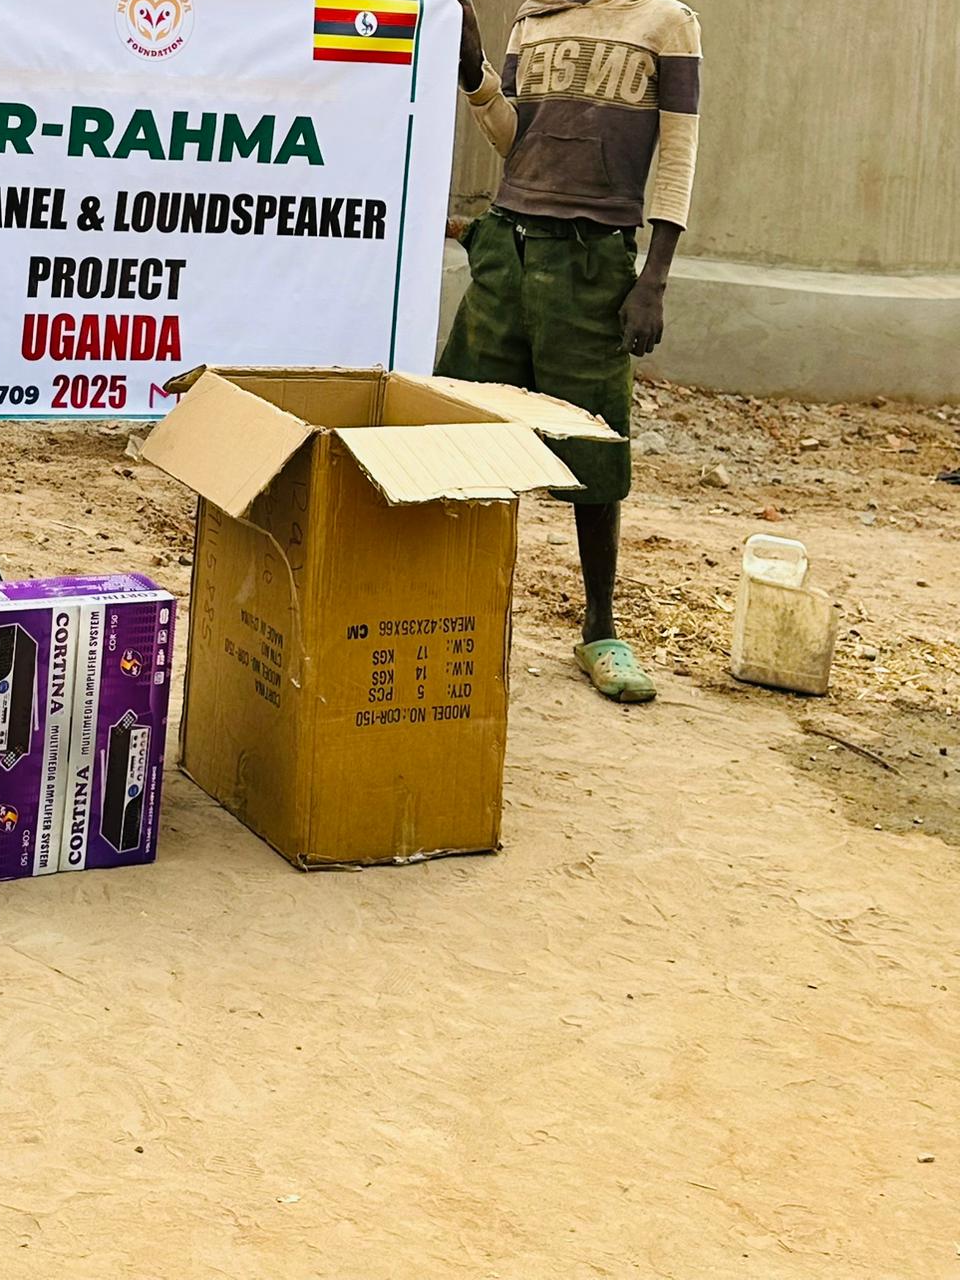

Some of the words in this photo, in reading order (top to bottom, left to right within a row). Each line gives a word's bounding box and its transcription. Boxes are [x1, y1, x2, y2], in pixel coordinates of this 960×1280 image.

[127, 36, 183, 57] FOUNDATION
[77, 196, 106, 232] &
[114, 191, 387, 240] LOUNDSPEAKER
[27, 256, 187, 300] PROJECT
[21, 313, 182, 362] UGANDA
[51, 374, 127, 410] 2025
[89, 611, 100, 647] SYSTEM
[109, 614, 119, 652] COR-150
[266, 625, 283, 648] MADE
[347, 624, 369, 640] CM
[51, 612, 69, 715] CORTINA
[372, 649, 395, 666] KGS
[417, 646, 428, 660] 17
[85, 650, 97, 698] AMPLIFIER
[262, 662, 281, 688] MODEL
[372, 669, 394, 686] KGS
[416, 666, 427, 680] 14
[254, 678, 281, 708] CORTINA
[368, 686, 393, 703] PCS
[417, 684, 425, 700] 5
[448, 683, 472, 699] QTY:
[81, 699, 94, 755] MULTIMEDIA
[432, 704, 471, 722] MODEL
[47, 725, 59, 781] MULTIMEDIA
[43, 784, 55, 831] AMPLIFIER
[68, 765, 90, 865] CORTINA
[20, 829, 31, 866] COR-150
[39, 833, 50, 868] SYSTEM
